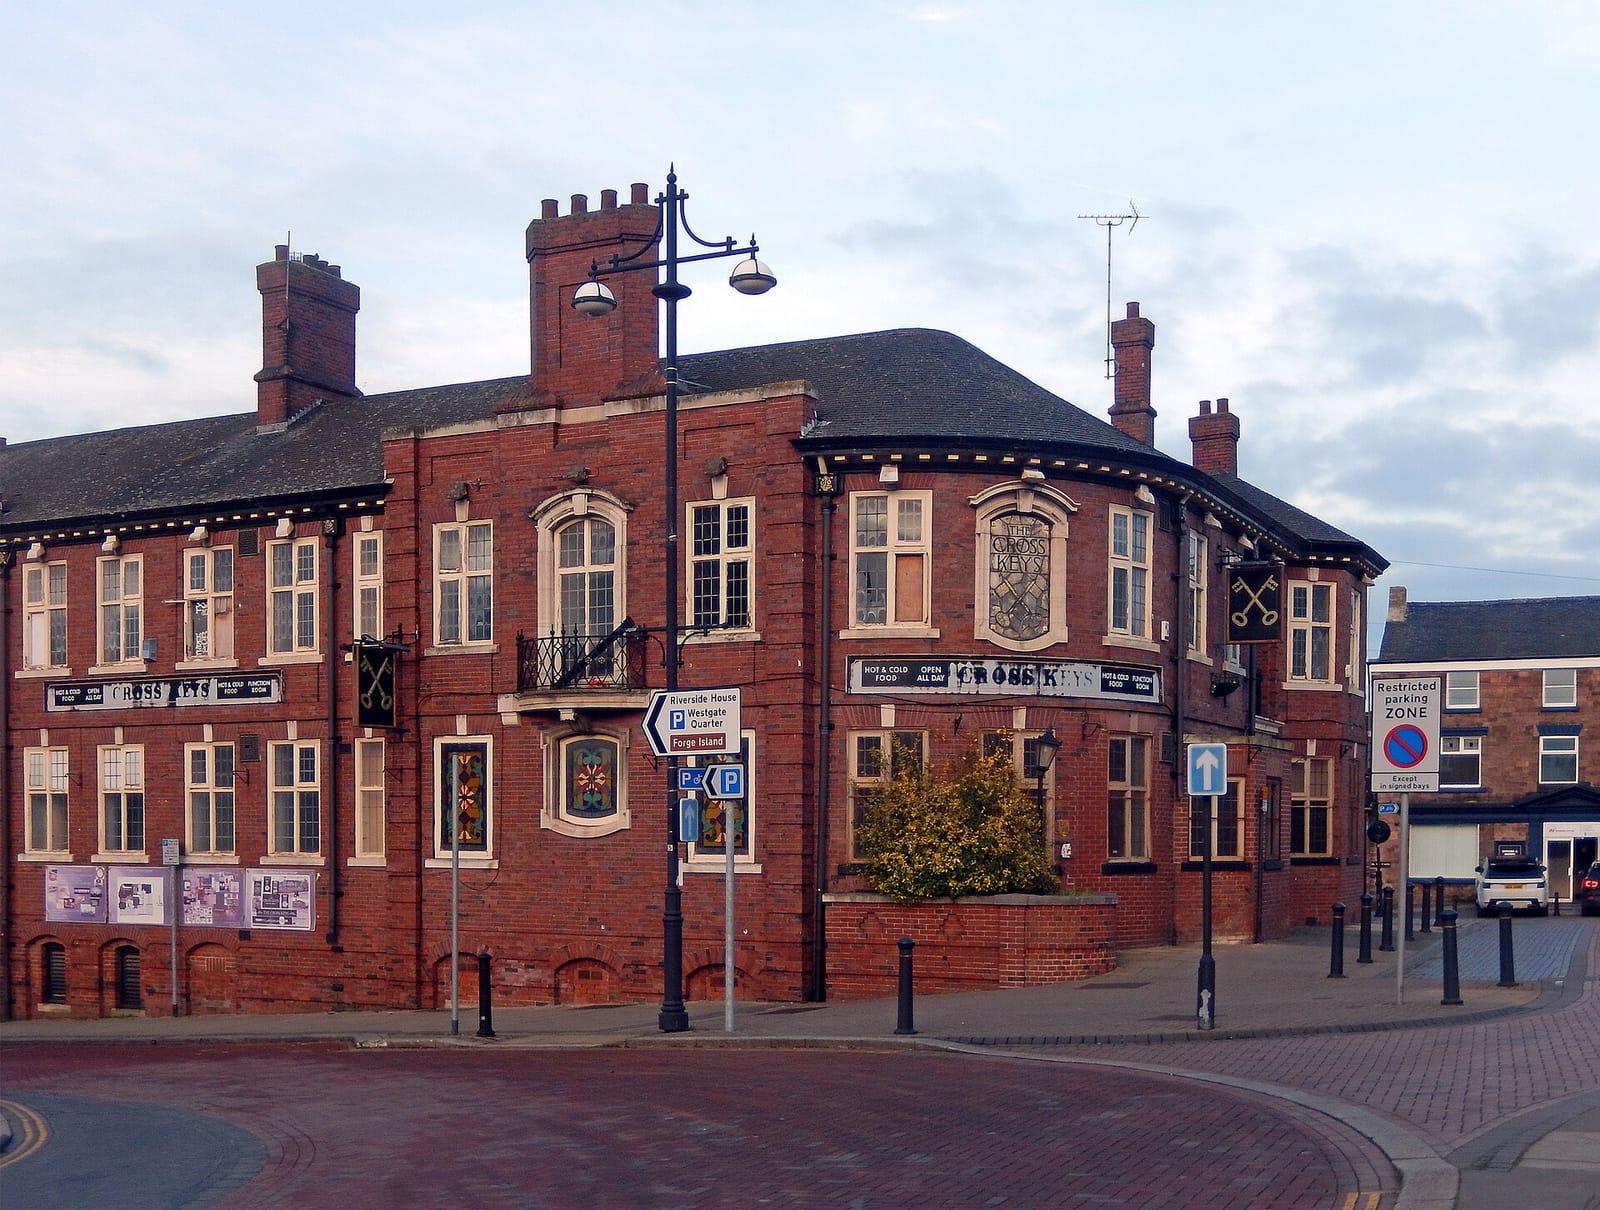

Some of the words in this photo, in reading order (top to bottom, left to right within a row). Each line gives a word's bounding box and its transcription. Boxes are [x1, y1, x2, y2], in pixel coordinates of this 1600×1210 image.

[1009, 525, 1031, 536] THE
[993, 536, 1046, 555] CROSS
[997, 555, 1042, 572] KEYS
[875, 674, 898, 682] FOOD
[916, 674, 929, 682] ALL
[931, 674, 945, 682] DAY
[957, 666, 1034, 686] CROSS
[1109, 680, 1124, 688] FOOD
[1377, 681, 1437, 692] Restricted
[670, 695, 708, 704] Riverside
[710, 693, 737, 702] House
[1385, 694, 1428, 705] parking
[687, 708, 727, 718] Westgate
[1385, 707, 1428, 719] ZONE
[673, 711, 683, 728] P
[690, 719, 723, 728] Quarter
[673, 738, 696, 749] Forge
[698, 736, 723, 747] Island
[681, 772, 691, 785] P
[725, 771, 738, 792] P
[1392, 775, 1417, 783] Except
